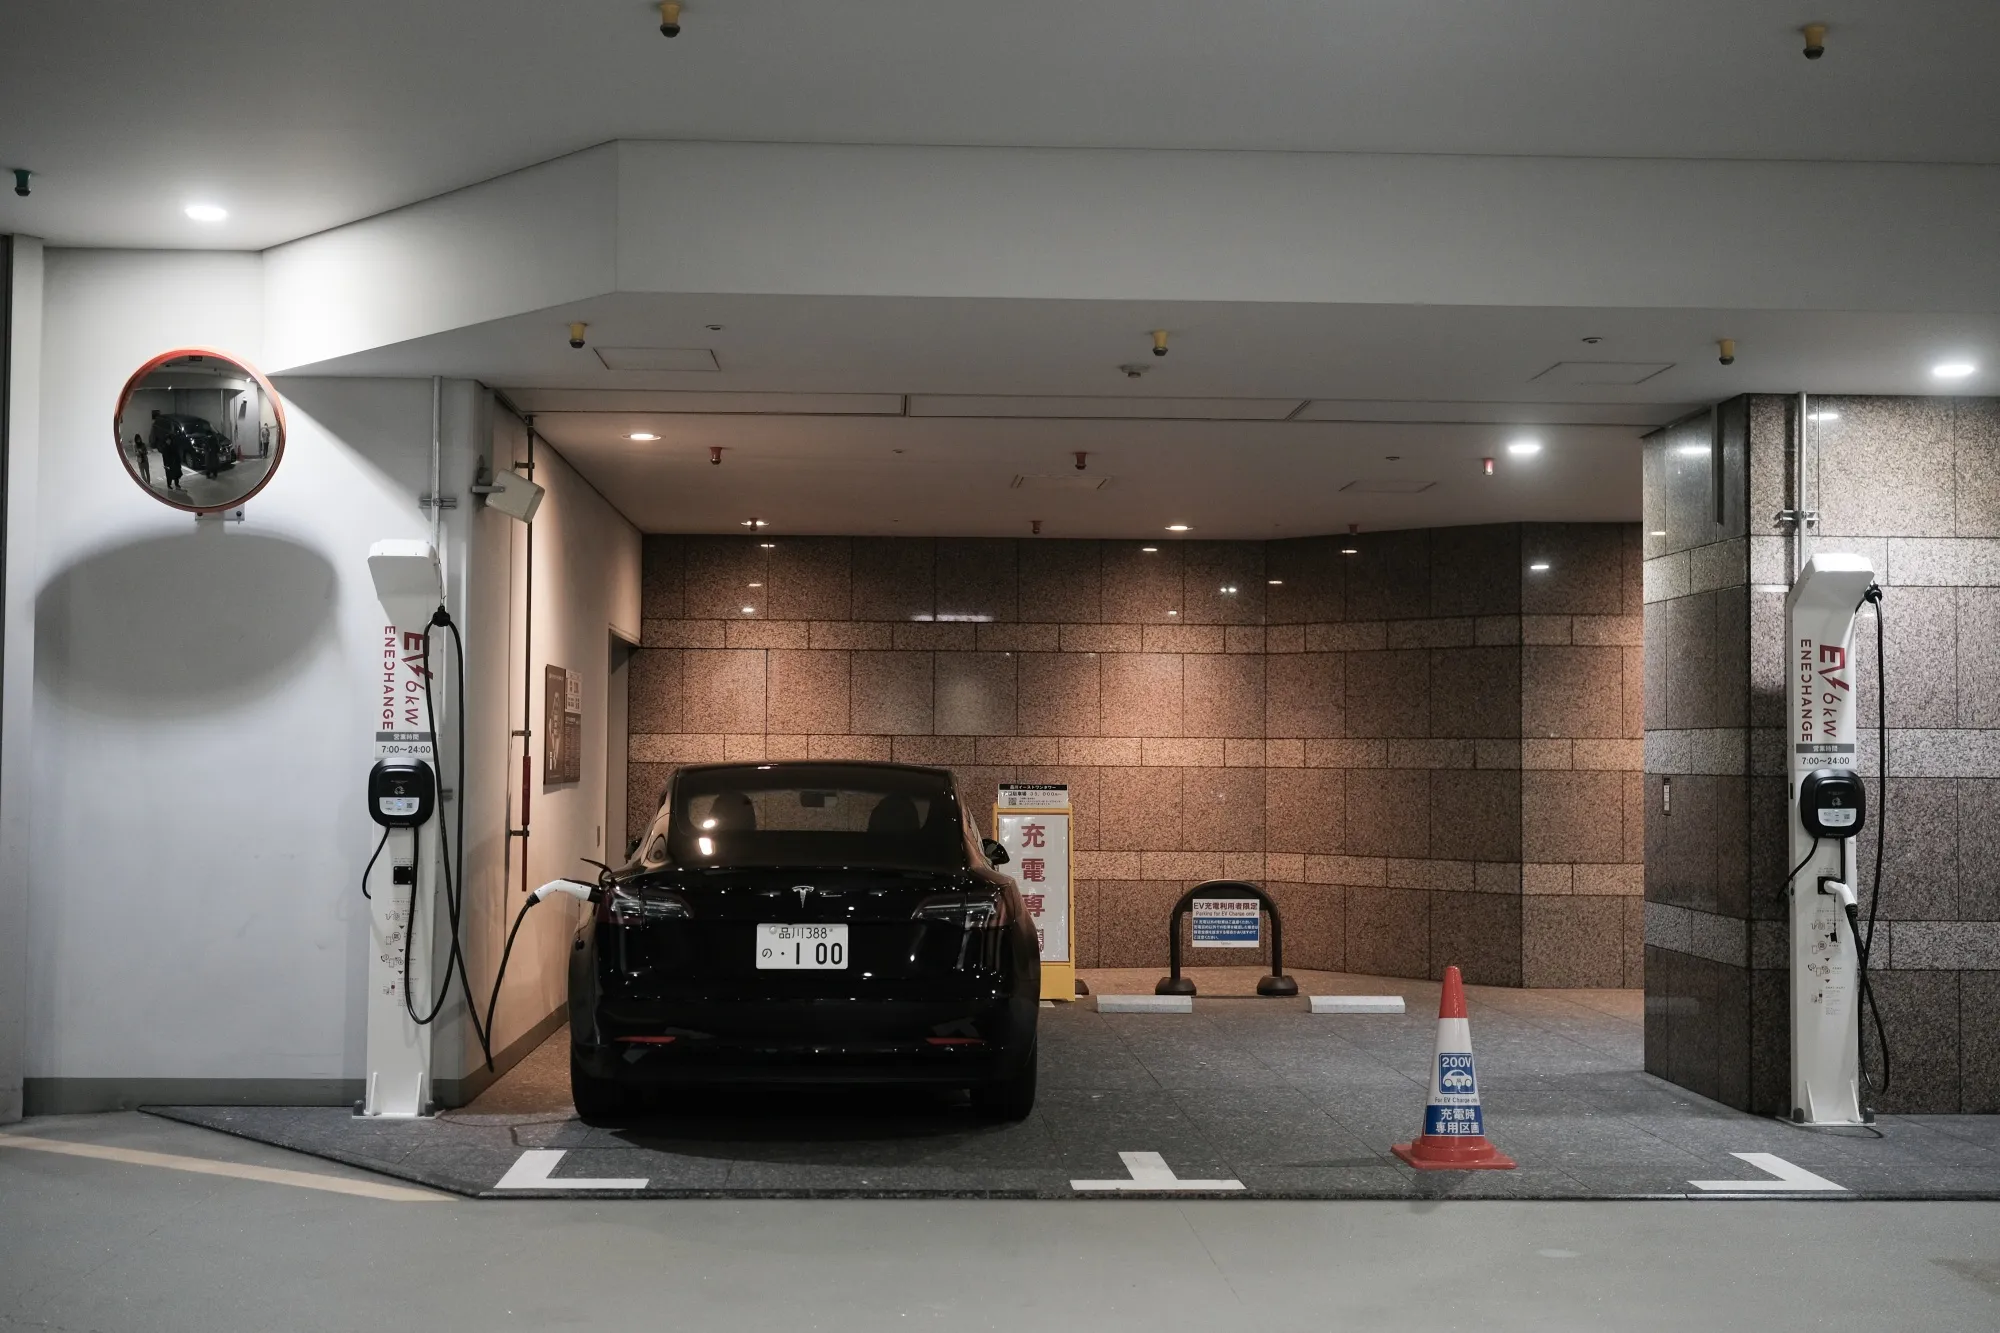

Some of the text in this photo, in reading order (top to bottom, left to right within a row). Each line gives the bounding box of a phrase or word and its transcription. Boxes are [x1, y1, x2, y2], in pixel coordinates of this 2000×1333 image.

[401, 631, 434, 726] EV 6kW
[1818, 644, 1850, 737] EV 6kW
[762, 948, 772, 958] の
[1442, 1057, 1471, 1068] 200V
[1440, 1108, 1475, 1120] 充電時
[1435, 1121, 1480, 1134] 専用区画
